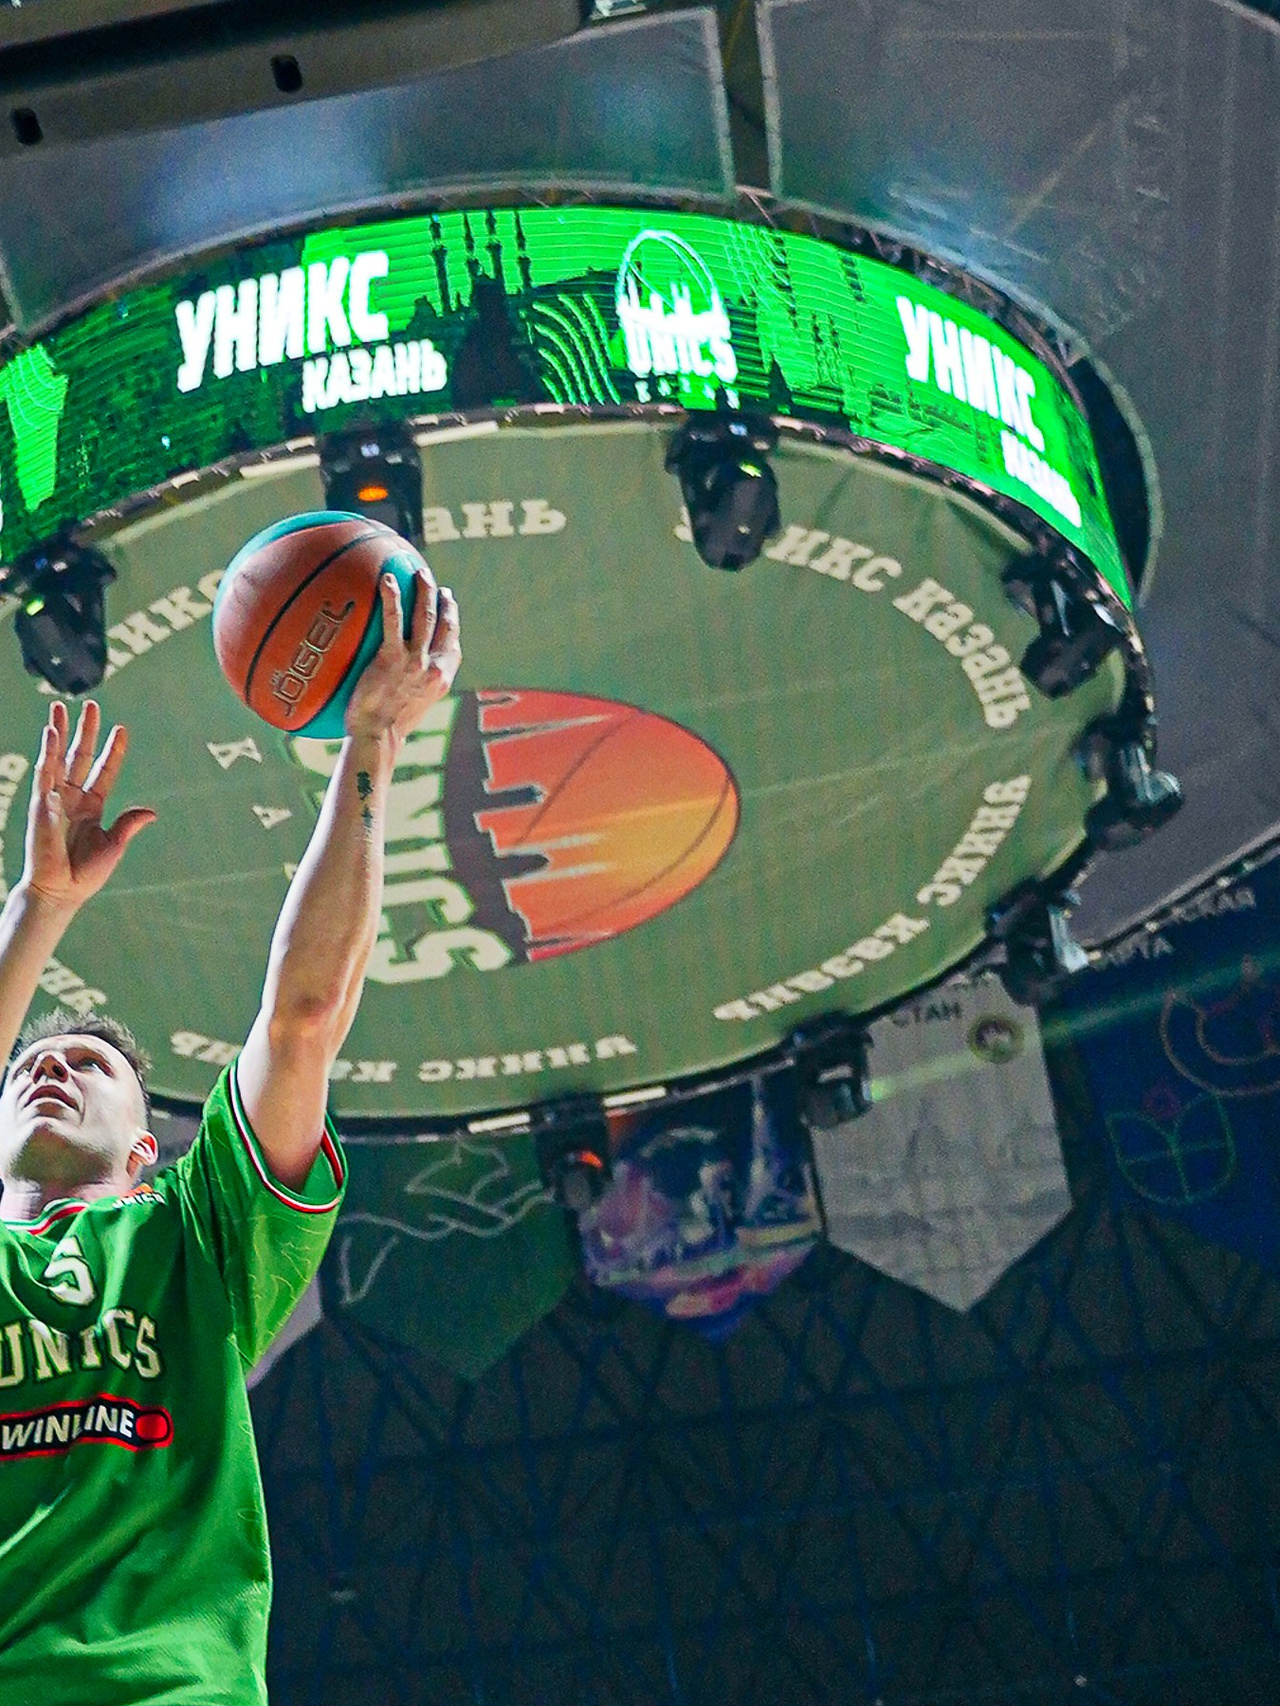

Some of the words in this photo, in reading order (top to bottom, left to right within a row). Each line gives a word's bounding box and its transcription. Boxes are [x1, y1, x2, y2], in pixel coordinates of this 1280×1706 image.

[175, 250, 389, 393] УНИКС
[302, 338, 448, 414] КАЗАНЬ
[896, 295, 1045, 453] УНИКС
[423, 499, 567, 543] ань
[1, 1404, 136, 1451] WINLINE
